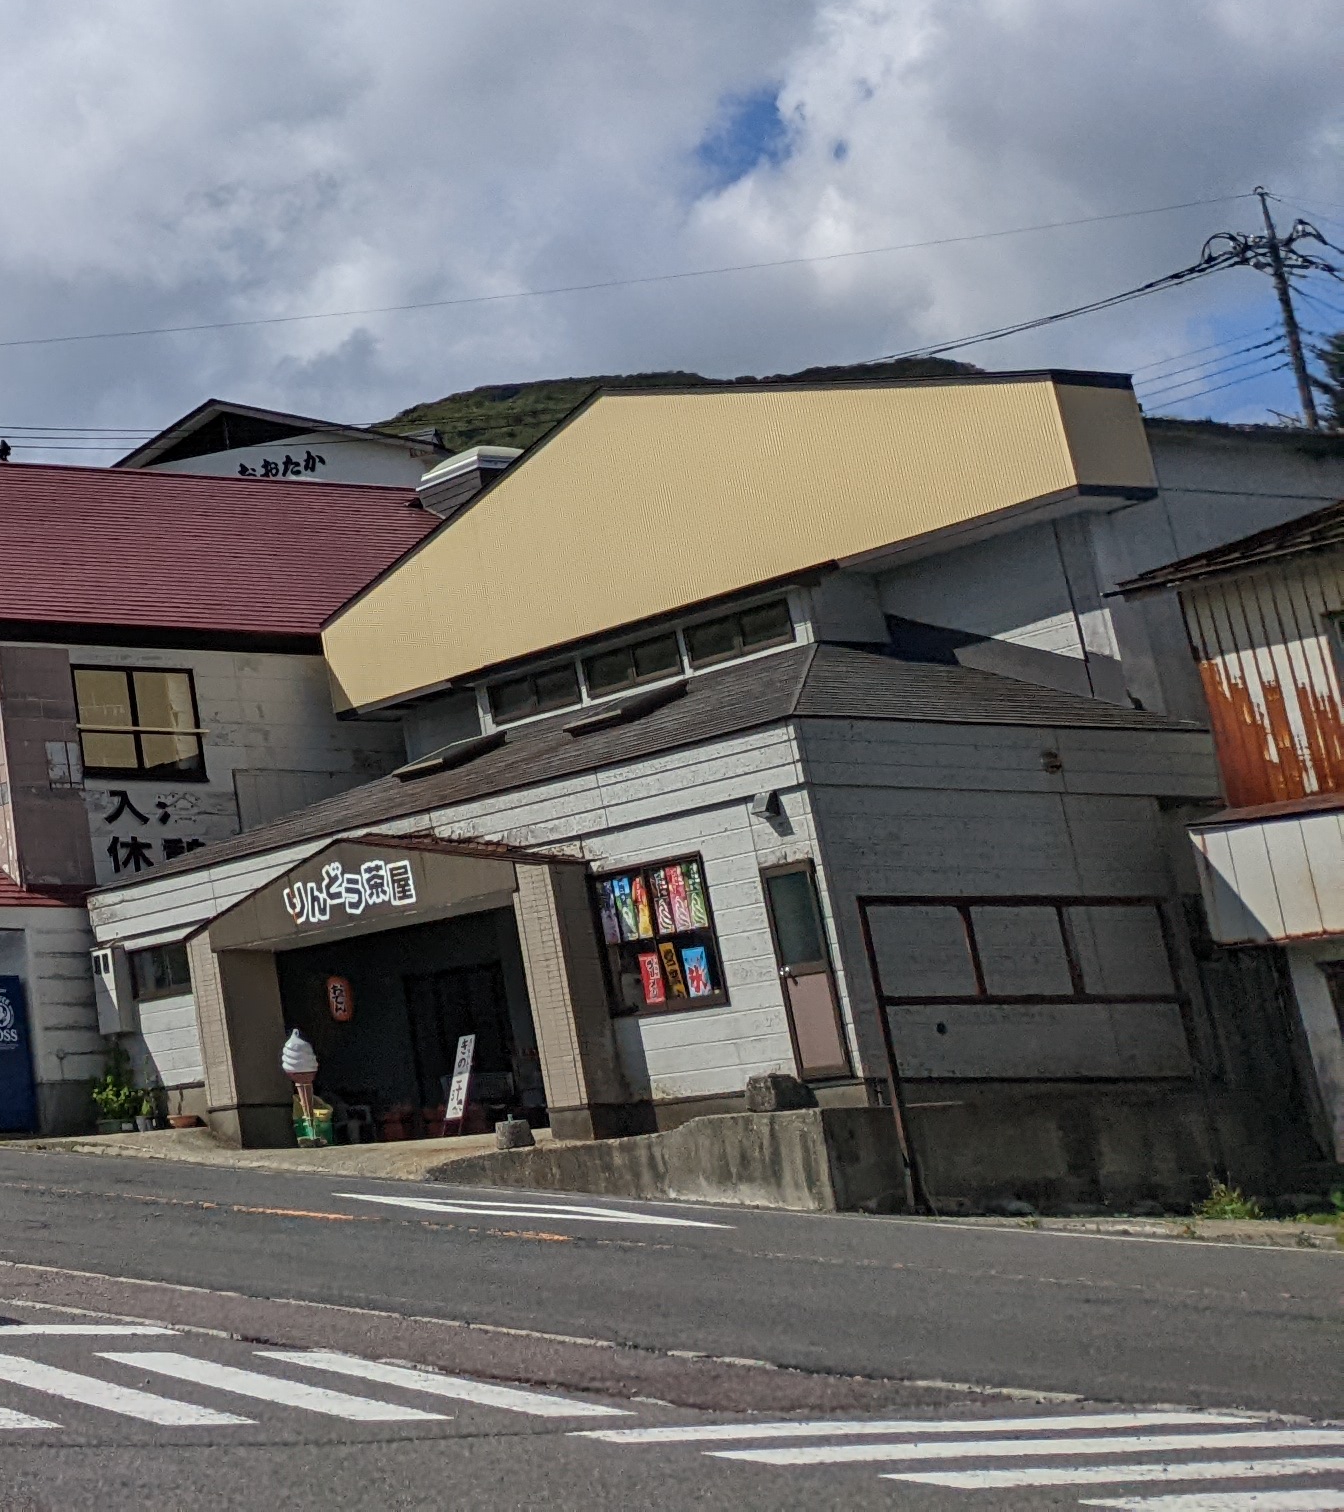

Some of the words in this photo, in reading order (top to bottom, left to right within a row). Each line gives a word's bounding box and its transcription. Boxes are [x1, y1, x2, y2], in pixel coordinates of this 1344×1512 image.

[283, 859, 417, 925] りんどう茶屋
[688, 965, 708, 994] 氷
[331, 984, 347, 1014] おでん
